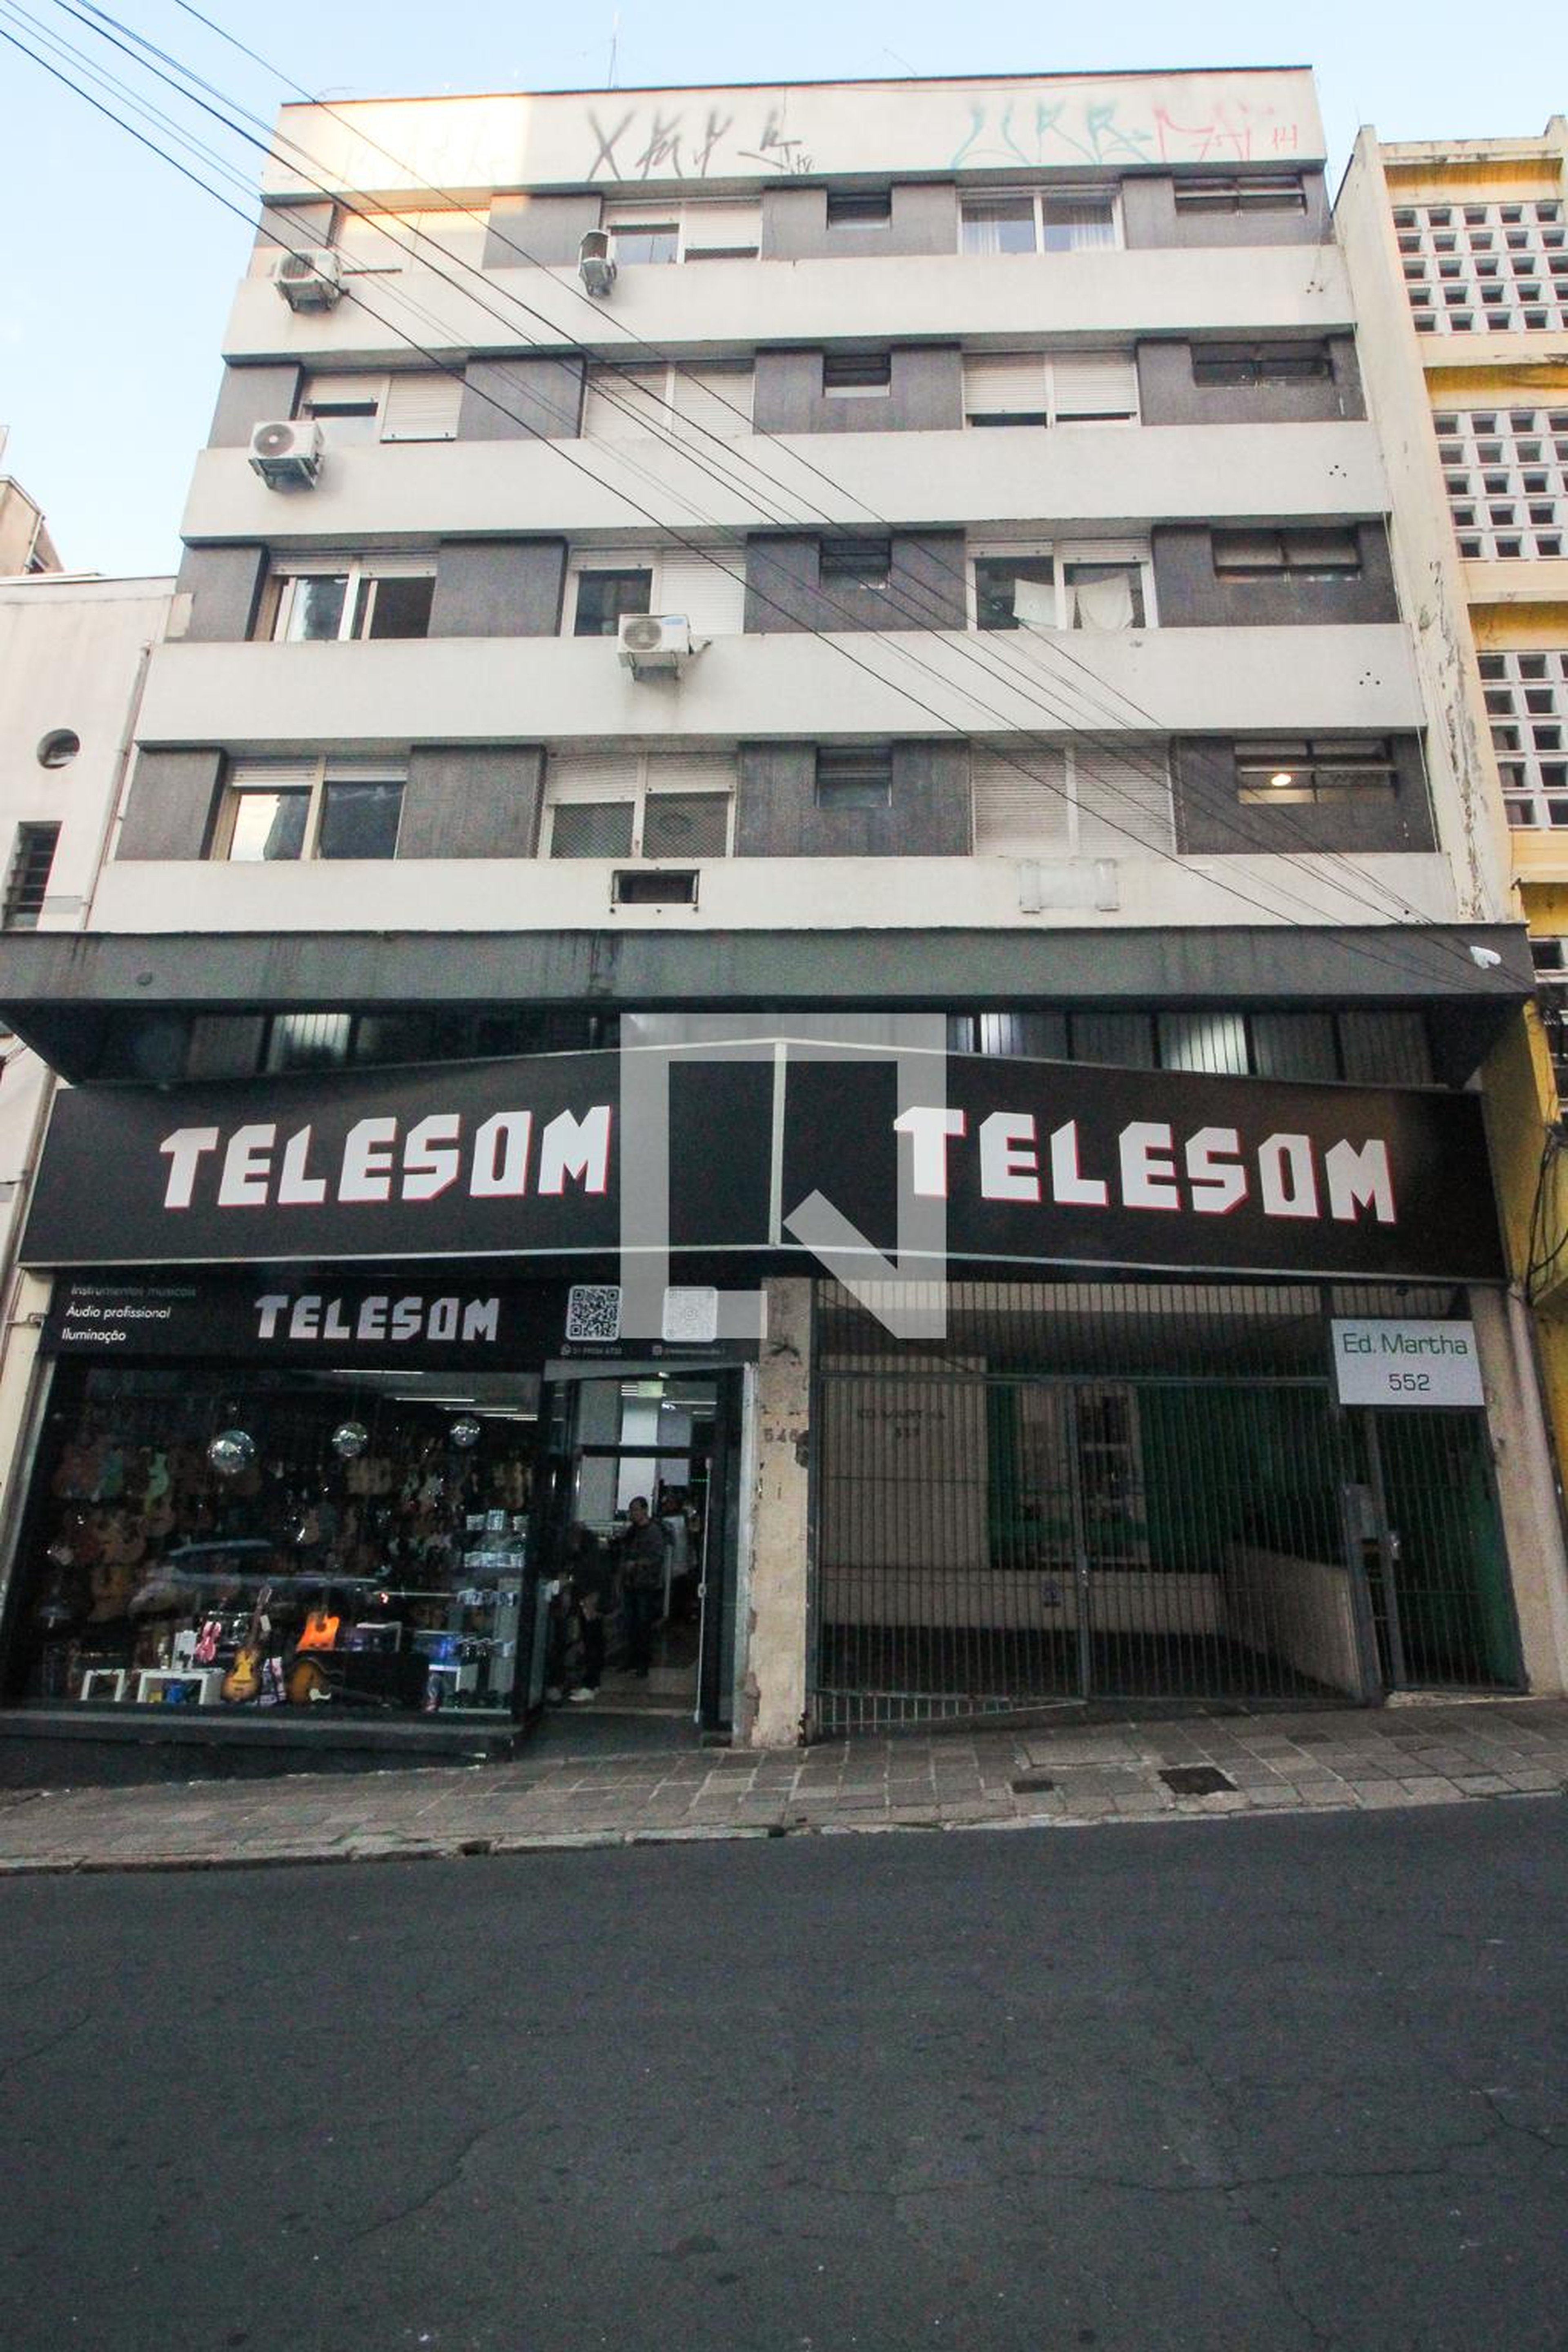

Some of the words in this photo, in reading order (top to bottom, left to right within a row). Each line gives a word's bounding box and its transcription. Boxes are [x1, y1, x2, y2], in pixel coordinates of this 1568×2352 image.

[159, 1105, 611, 1208] TELESOM
[893, 1106, 1396, 1225] TELESOM
[66, 1301, 101, 1318] Áudio
[103, 1306, 172, 1321] profissional
[254, 1295, 500, 1341] TELESOM
[62, 1327, 126, 1344] Iluminação
[1343, 1333, 1376, 1354] Ed.
[1381, 1332, 1468, 1355] Martha
[1389, 1373, 1431, 1391] 552
